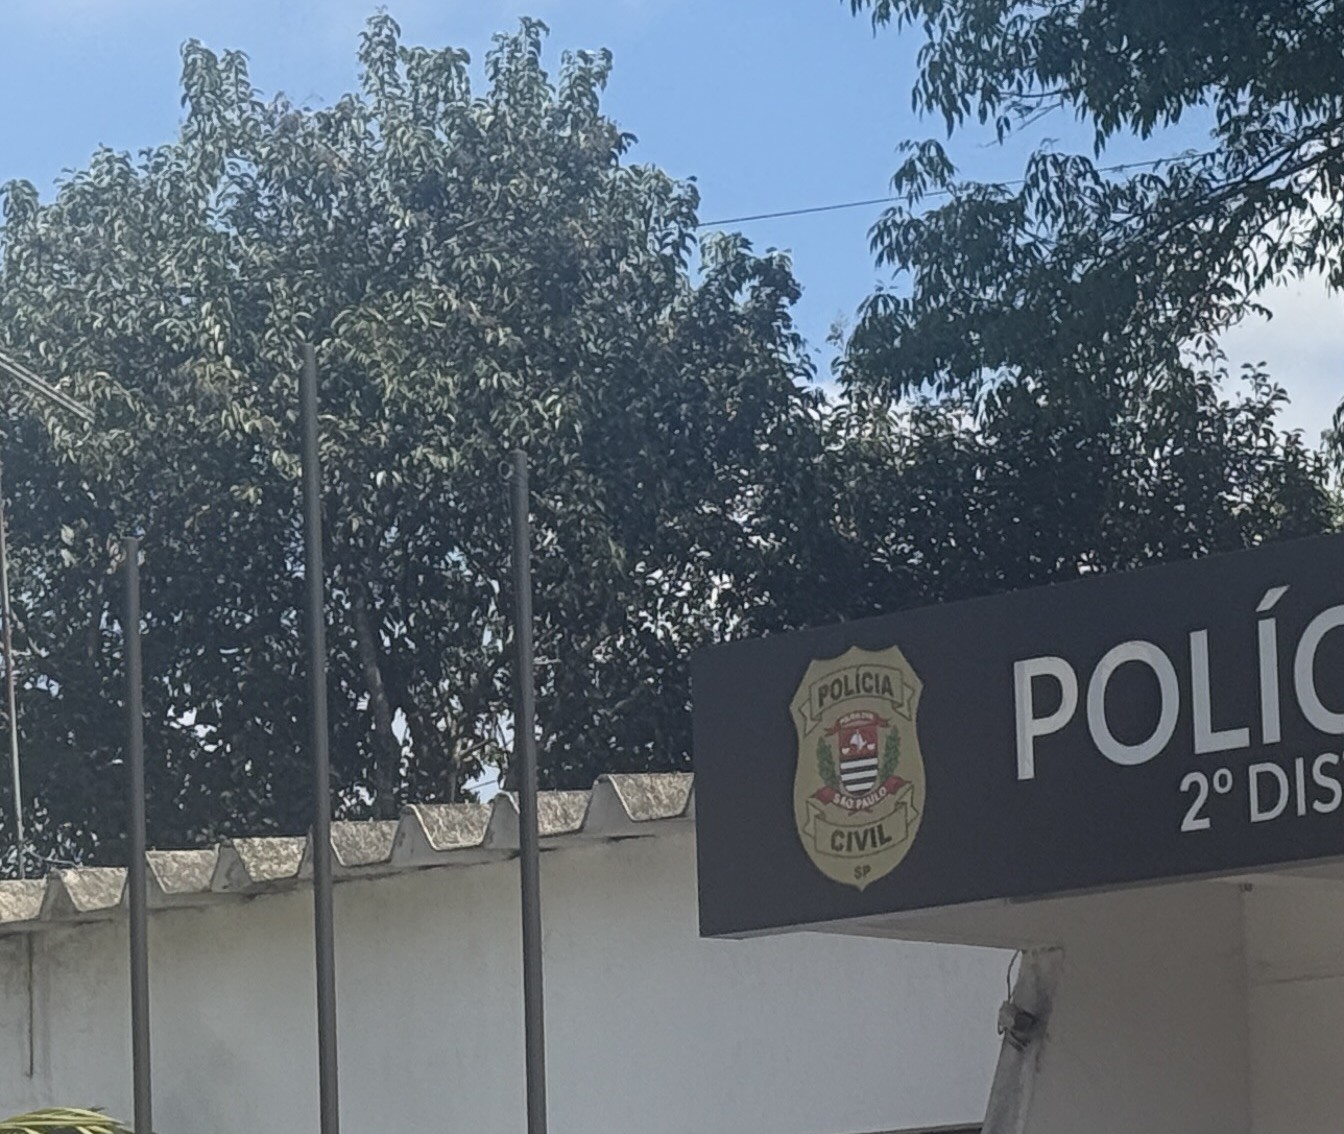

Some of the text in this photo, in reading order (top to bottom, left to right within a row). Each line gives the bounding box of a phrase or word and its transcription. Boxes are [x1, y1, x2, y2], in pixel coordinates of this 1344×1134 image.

[856, 786, 887, 809] PAULO
[831, 823, 893, 853] CIVIL
[854, 864, 872, 880] SP
